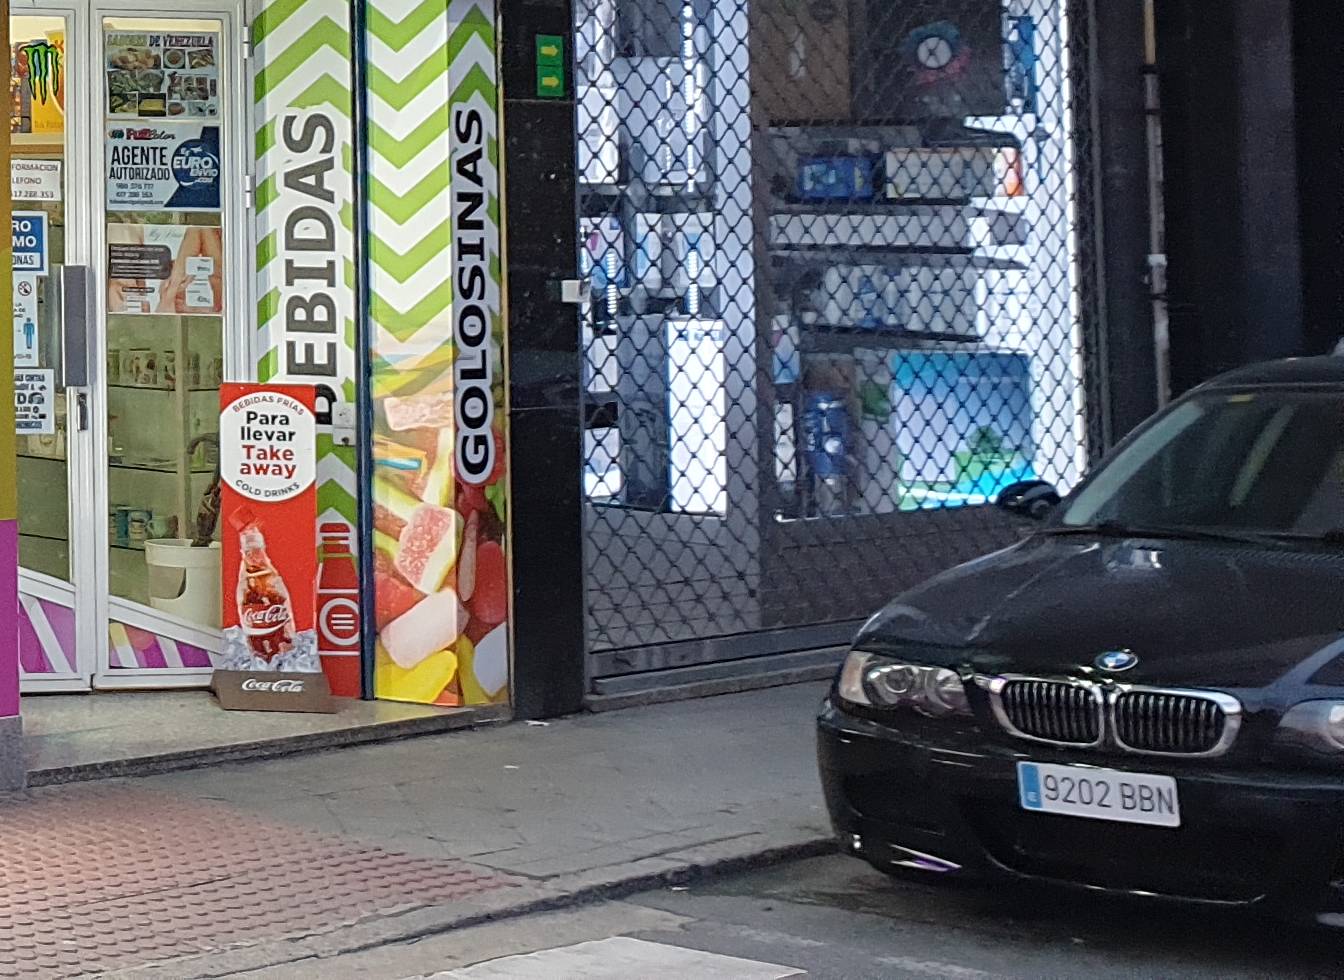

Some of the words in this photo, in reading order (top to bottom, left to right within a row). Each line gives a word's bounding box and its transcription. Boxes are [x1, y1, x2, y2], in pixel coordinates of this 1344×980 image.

[111, 146, 169, 166] AGENTE
[172, 156, 213, 169] EURO
[109, 166, 171, 181] AUTORIZADO
[455, 108, 490, 481] GOLOSINAS
[233, 395, 275, 413] BEBIDAS
[276, 397, 305, 416] FRÍAS
[246, 411, 290, 426] Para
[240, 426, 297, 442] llevar
[242, 444, 295, 461] Take
[239, 463, 297, 480] away
[235, 479, 262, 497] COLD
[264, 482, 301, 498] DRINKS
[1043, 773, 1113, 810] 9202
[1119, 782, 1177, 816] BBN
